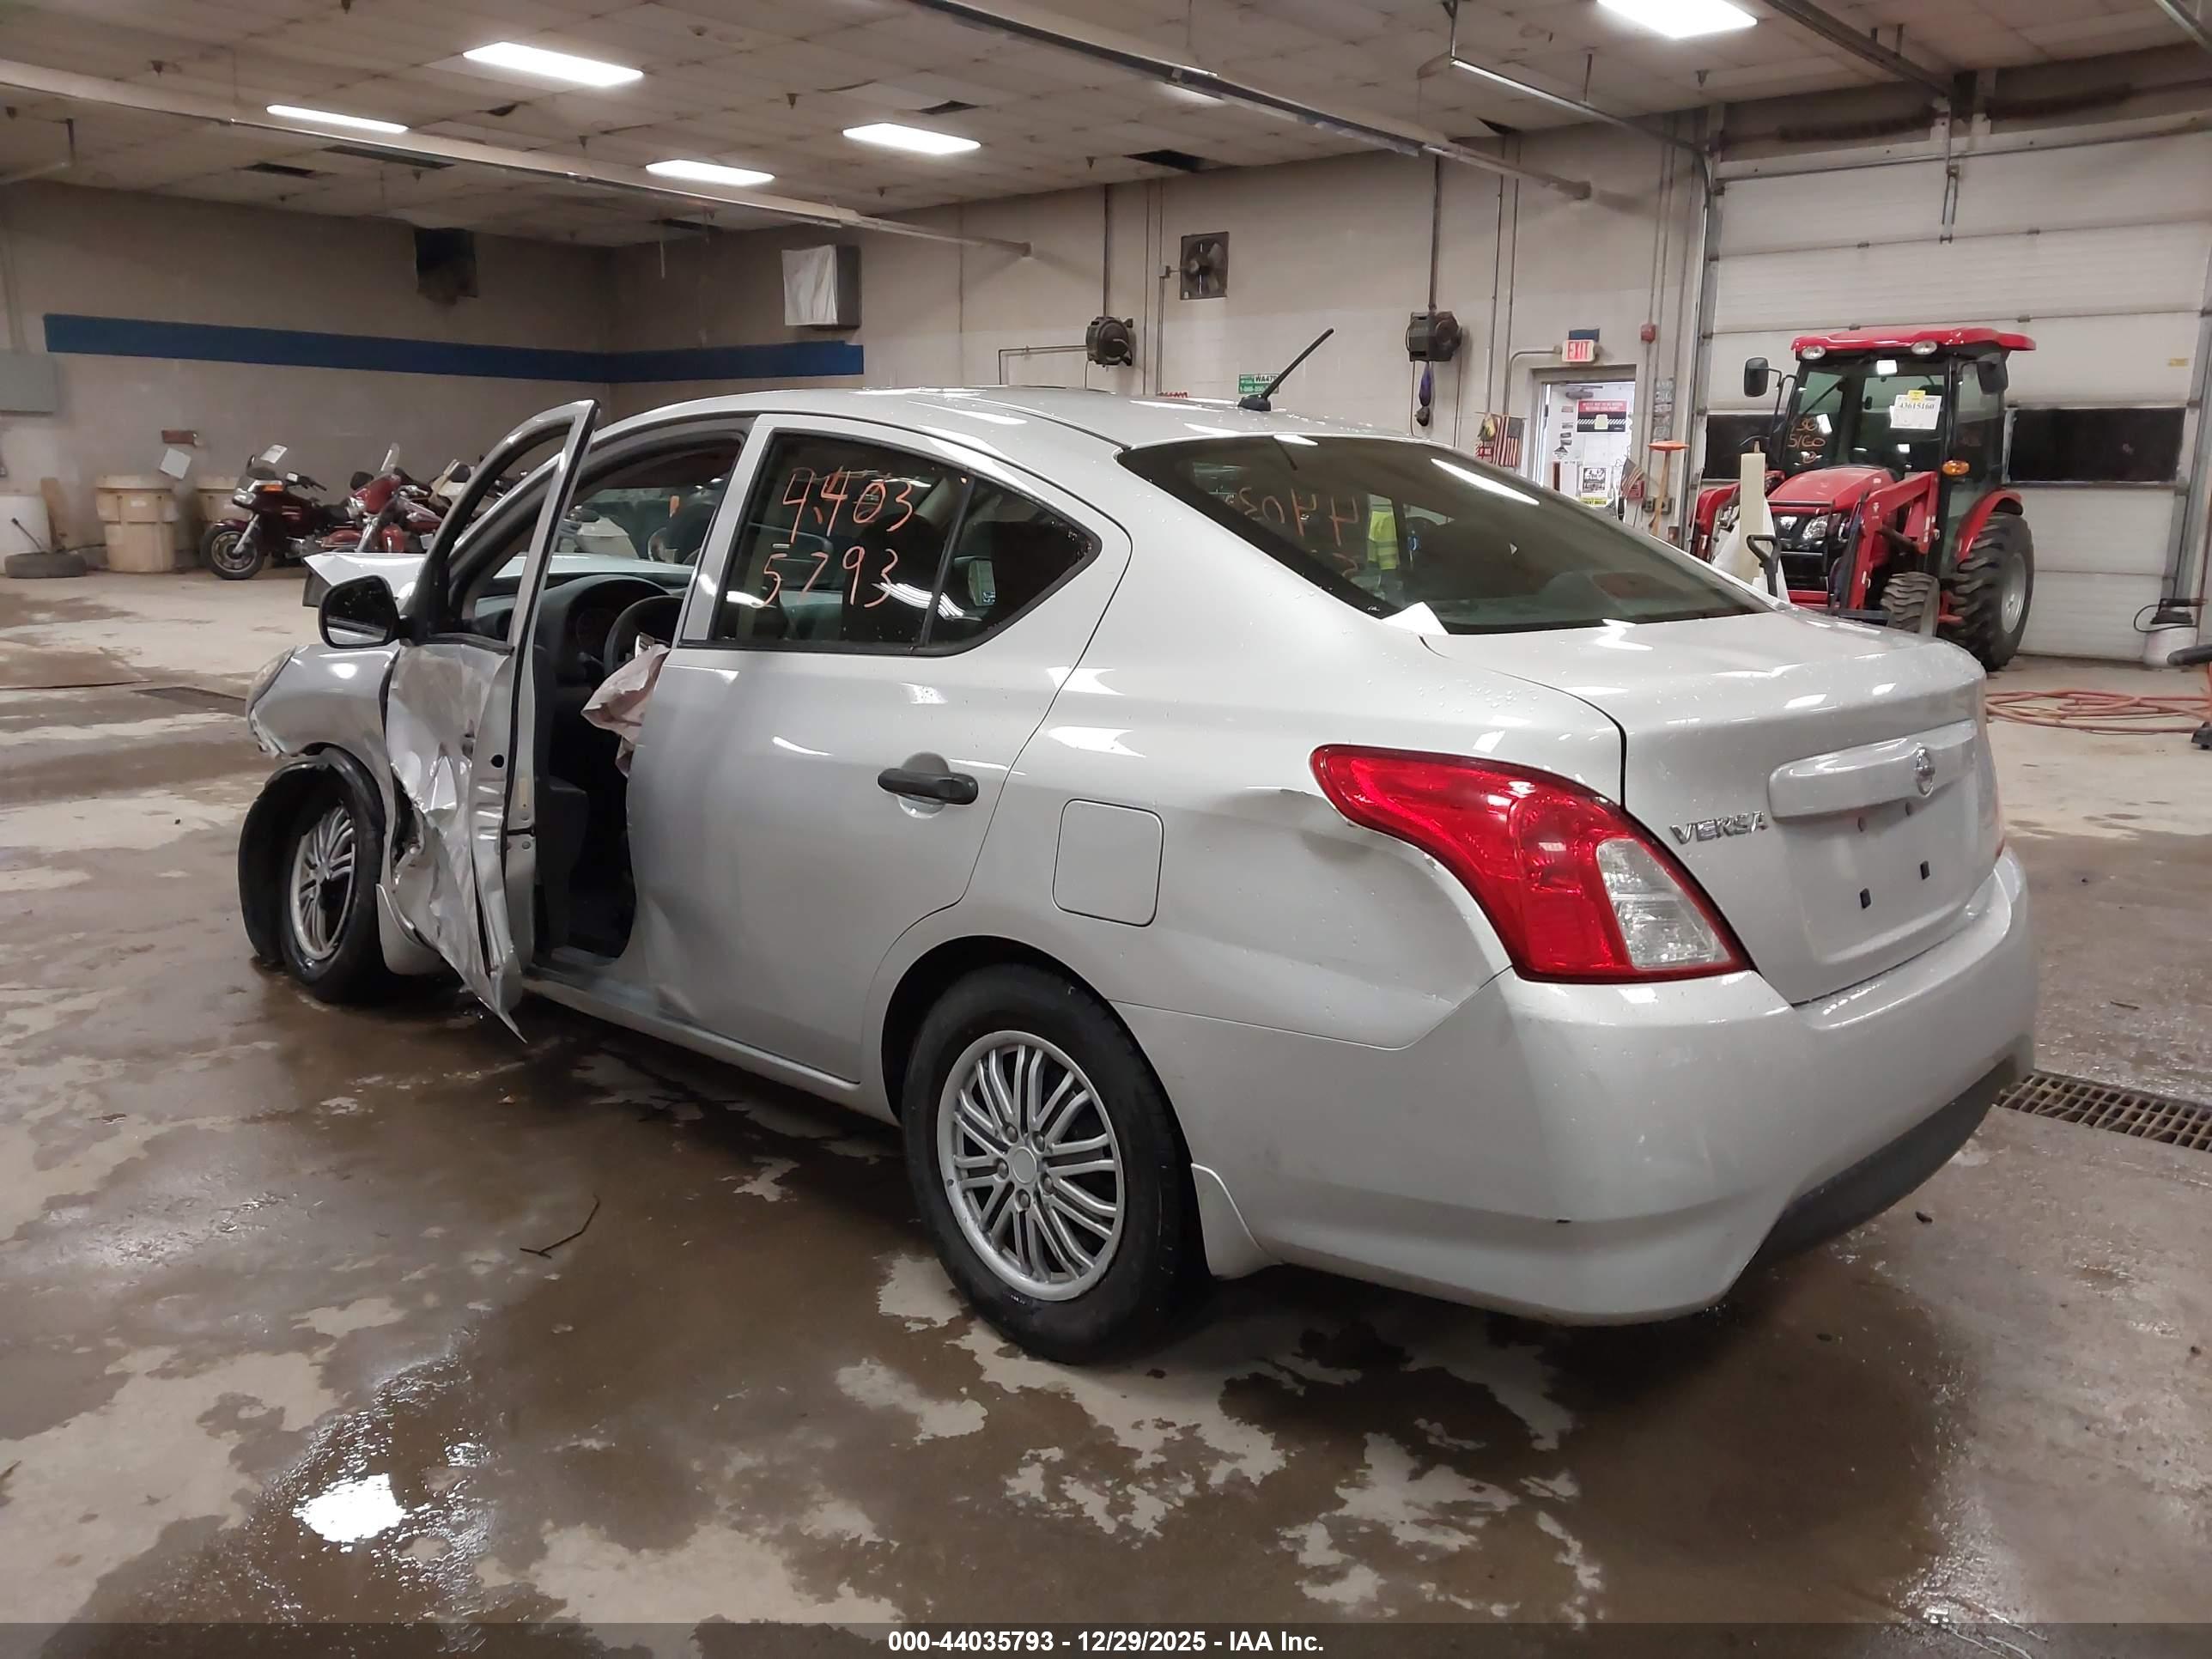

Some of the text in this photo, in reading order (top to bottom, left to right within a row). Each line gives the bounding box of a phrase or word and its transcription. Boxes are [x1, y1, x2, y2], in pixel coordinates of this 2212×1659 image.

[1567, 341, 1590, 360] EXIT
[750, 545, 899, 609] 5793
[1669, 811, 1769, 844] VERSA
